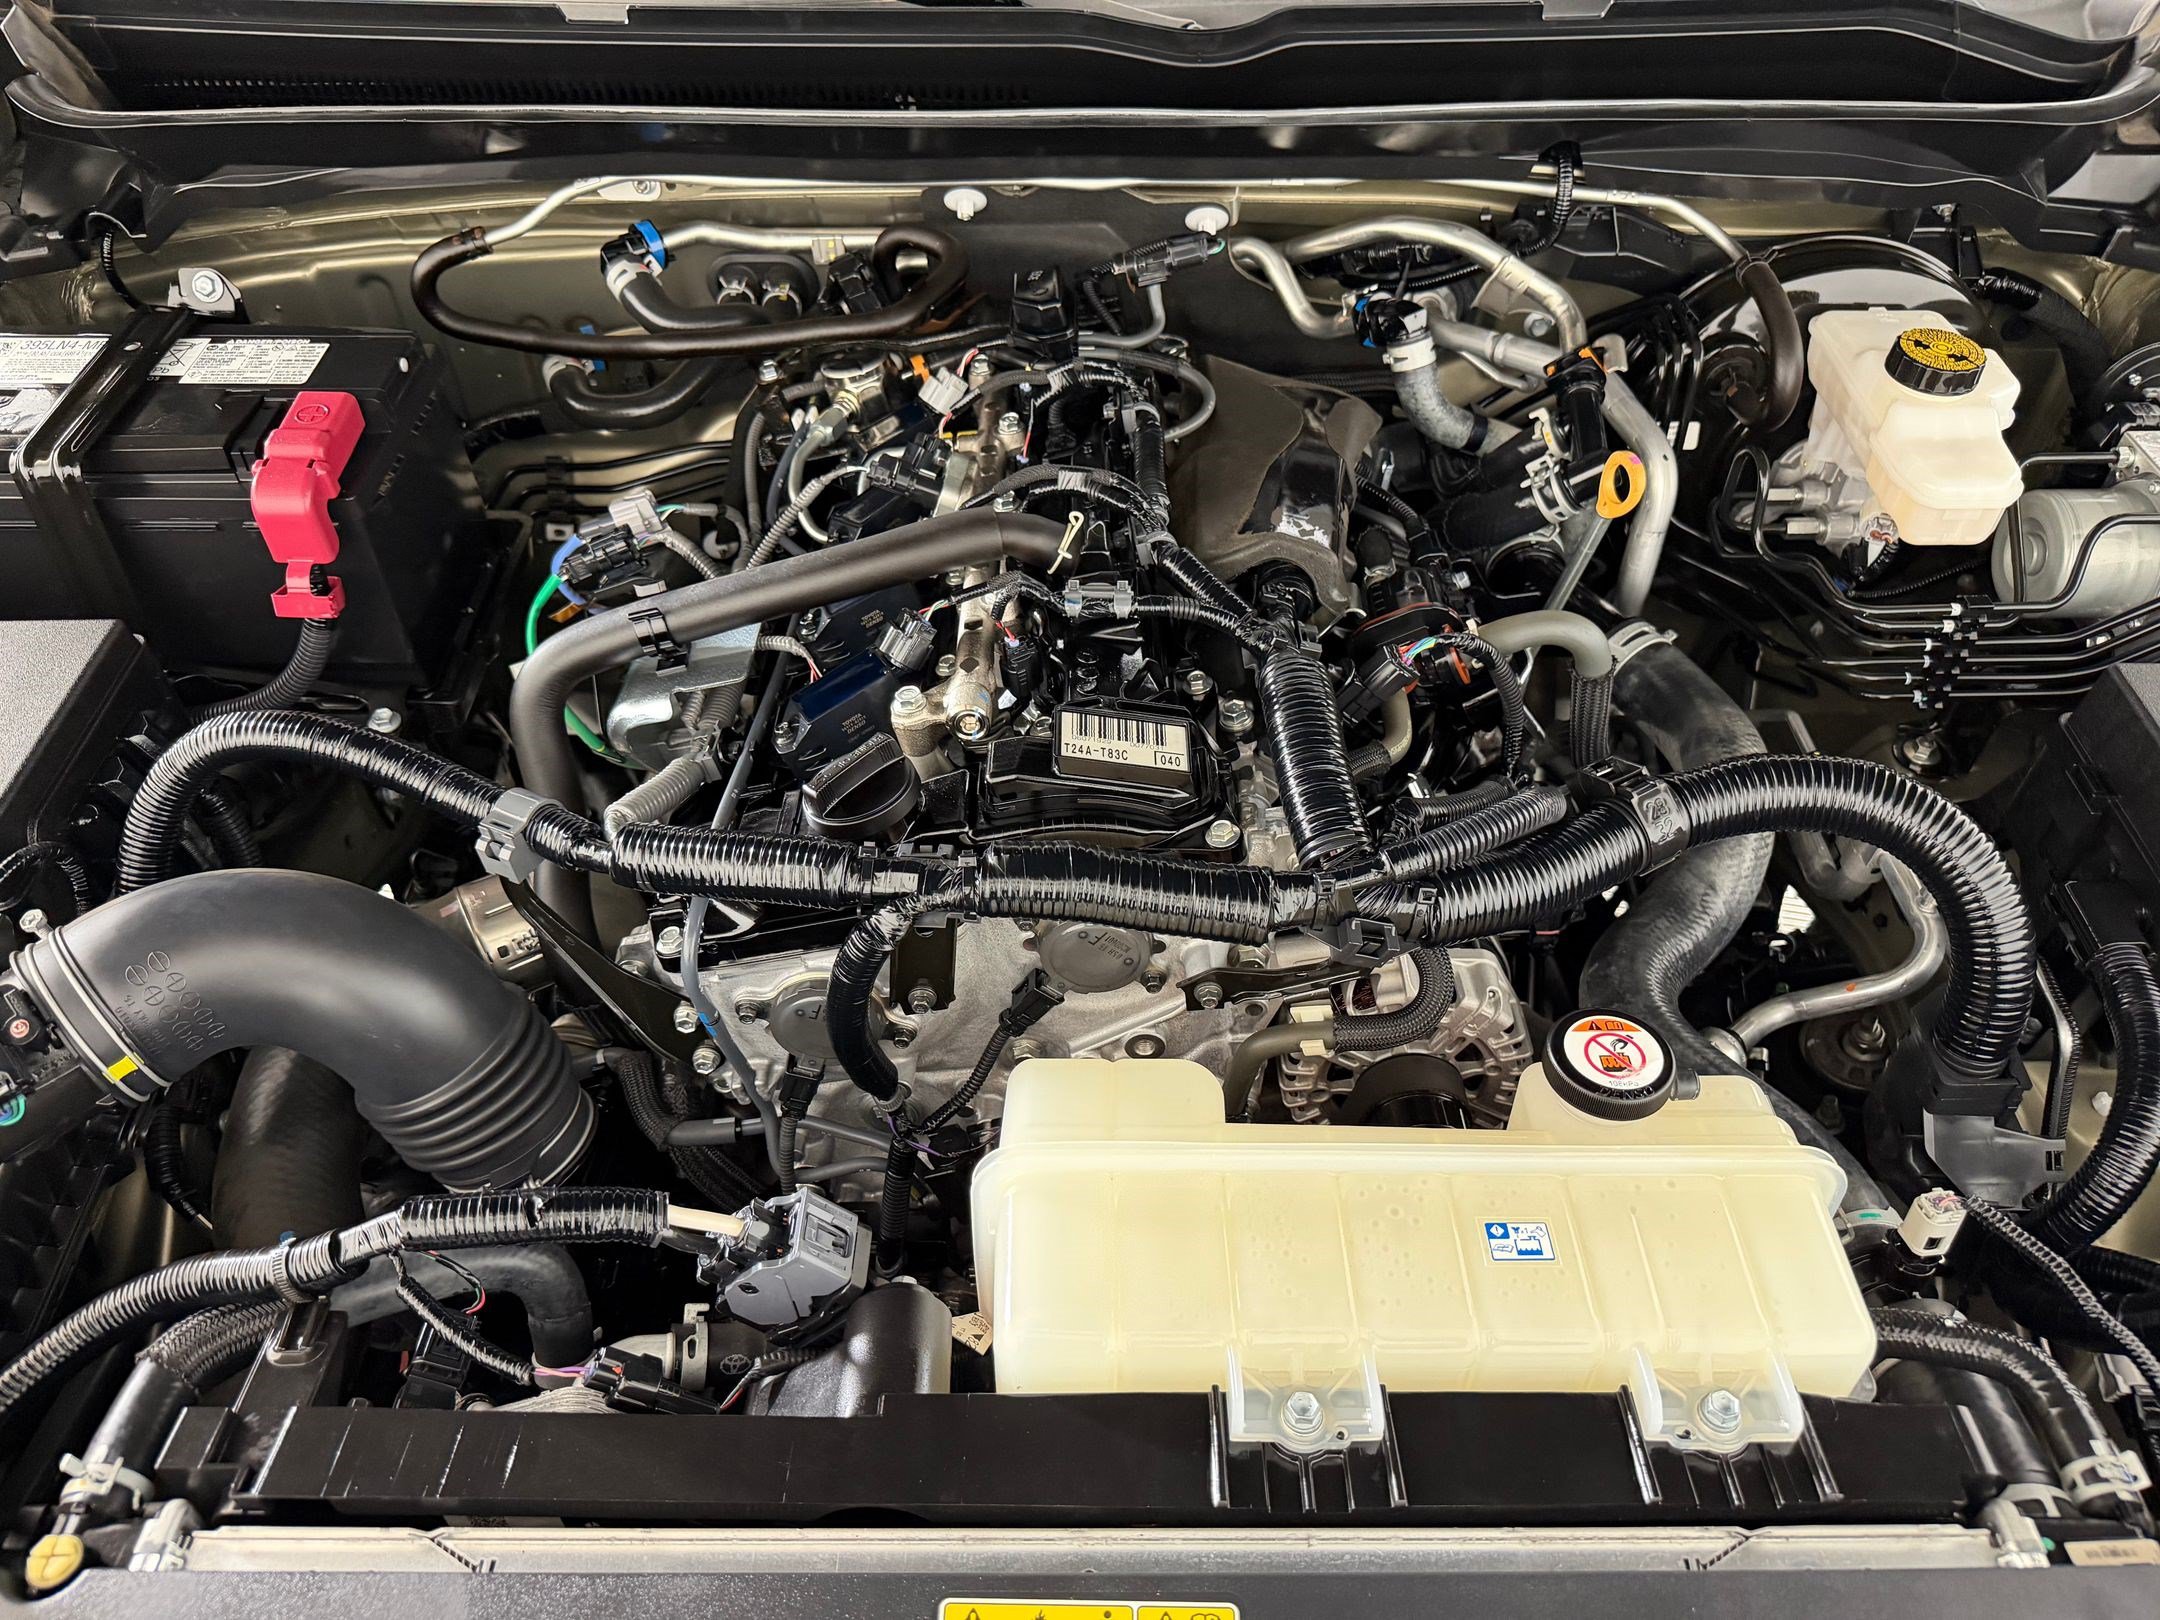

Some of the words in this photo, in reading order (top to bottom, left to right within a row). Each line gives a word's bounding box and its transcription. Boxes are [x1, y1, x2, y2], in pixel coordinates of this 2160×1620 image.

[841, 713, 863, 727] TOYOTA
[847, 720, 866, 734] DENSO
[1064, 742, 1129, 761] T24A-T83C
[1160, 754, 1181, 767] 040
[1595, 1085, 1655, 1100] DENSO
